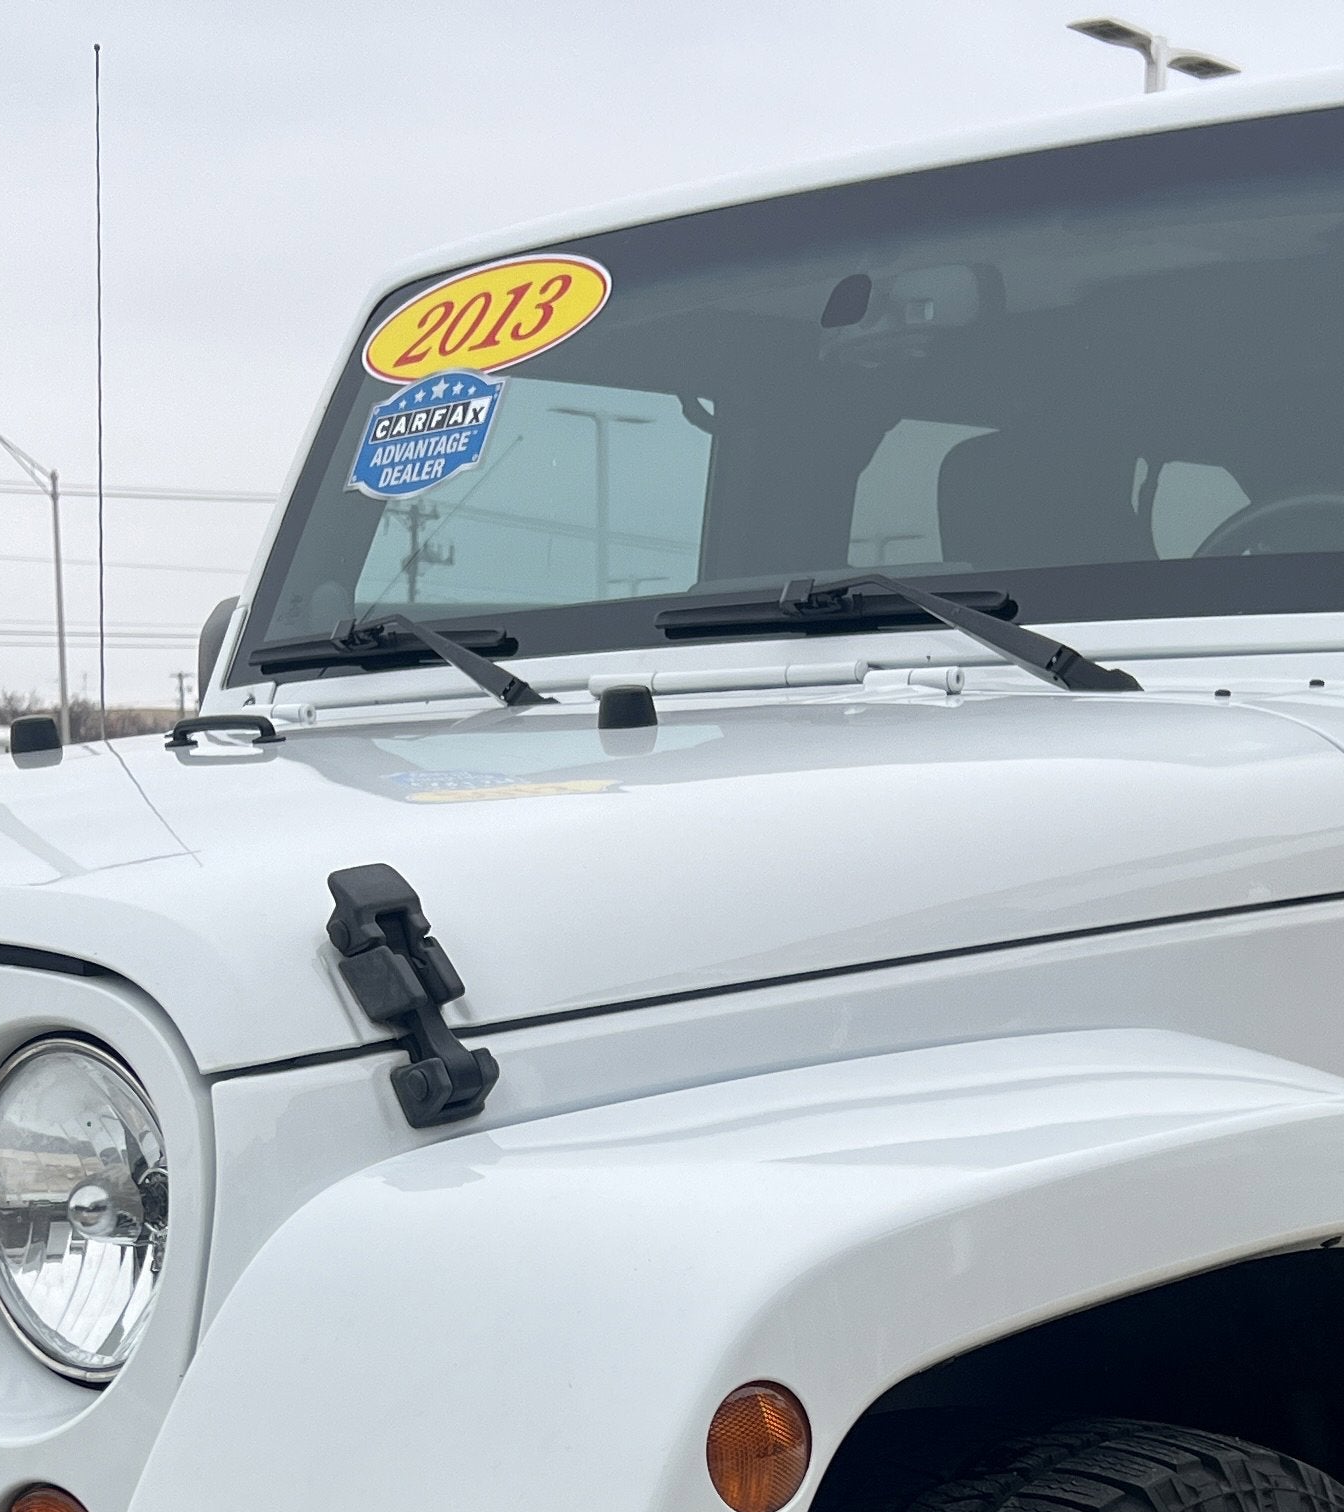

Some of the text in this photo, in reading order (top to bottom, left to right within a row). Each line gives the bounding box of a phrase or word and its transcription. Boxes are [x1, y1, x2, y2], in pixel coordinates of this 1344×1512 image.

[393, 274, 572, 368] 2013
[374, 403, 486, 440] CARFAX
[369, 430, 472, 468] ADVANTAGE
[378, 457, 446, 488] DEALER
